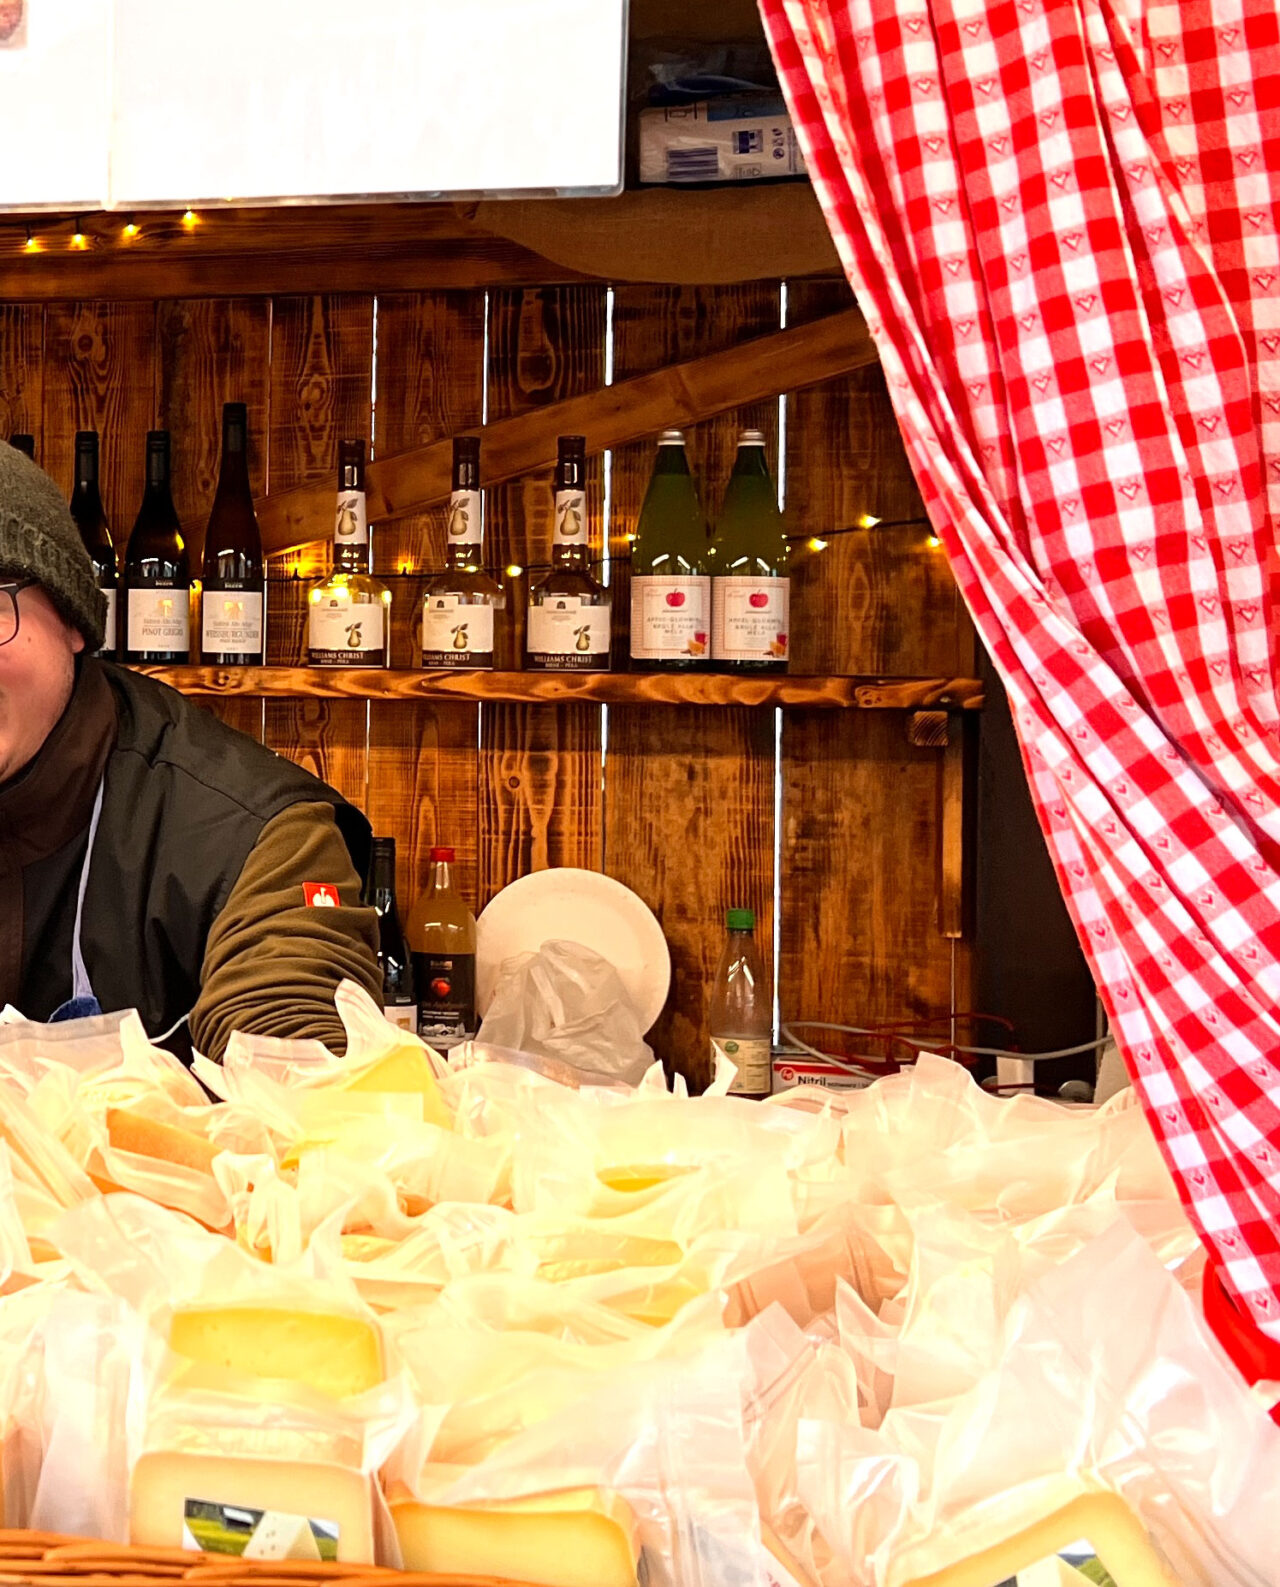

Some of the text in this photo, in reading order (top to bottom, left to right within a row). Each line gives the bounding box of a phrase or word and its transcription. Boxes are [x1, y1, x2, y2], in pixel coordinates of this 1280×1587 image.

[338, 652, 364, 660] CHRIST
[444, 653, 470, 661] CHRIST
[534, 655, 593, 663] WILLIAMS CHRIST
[797, 1076, 826, 1086] Nitril
